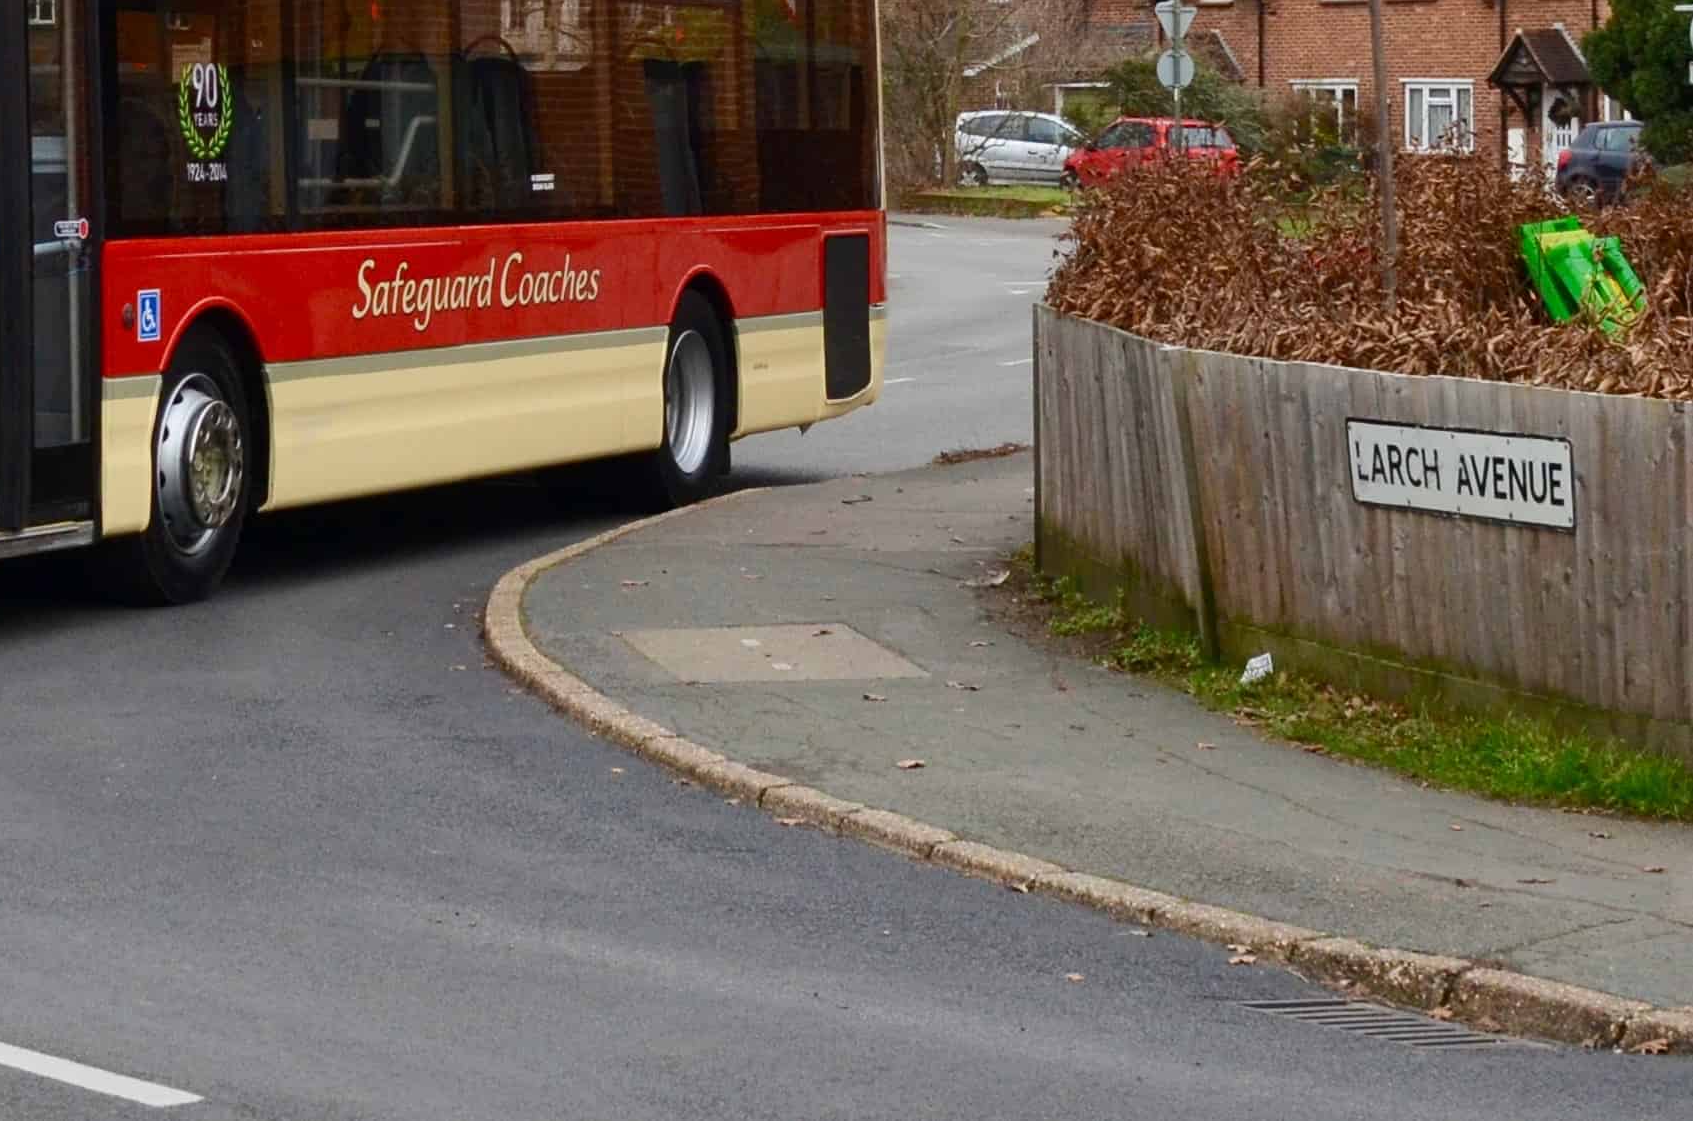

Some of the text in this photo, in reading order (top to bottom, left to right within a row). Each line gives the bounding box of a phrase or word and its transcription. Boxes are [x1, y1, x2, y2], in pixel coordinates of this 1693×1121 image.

[192, 62, 218, 108] 90
[351, 251, 601, 331] Safeguard Coaches
[1355, 441, 1565, 506] LARCH AVENUE
